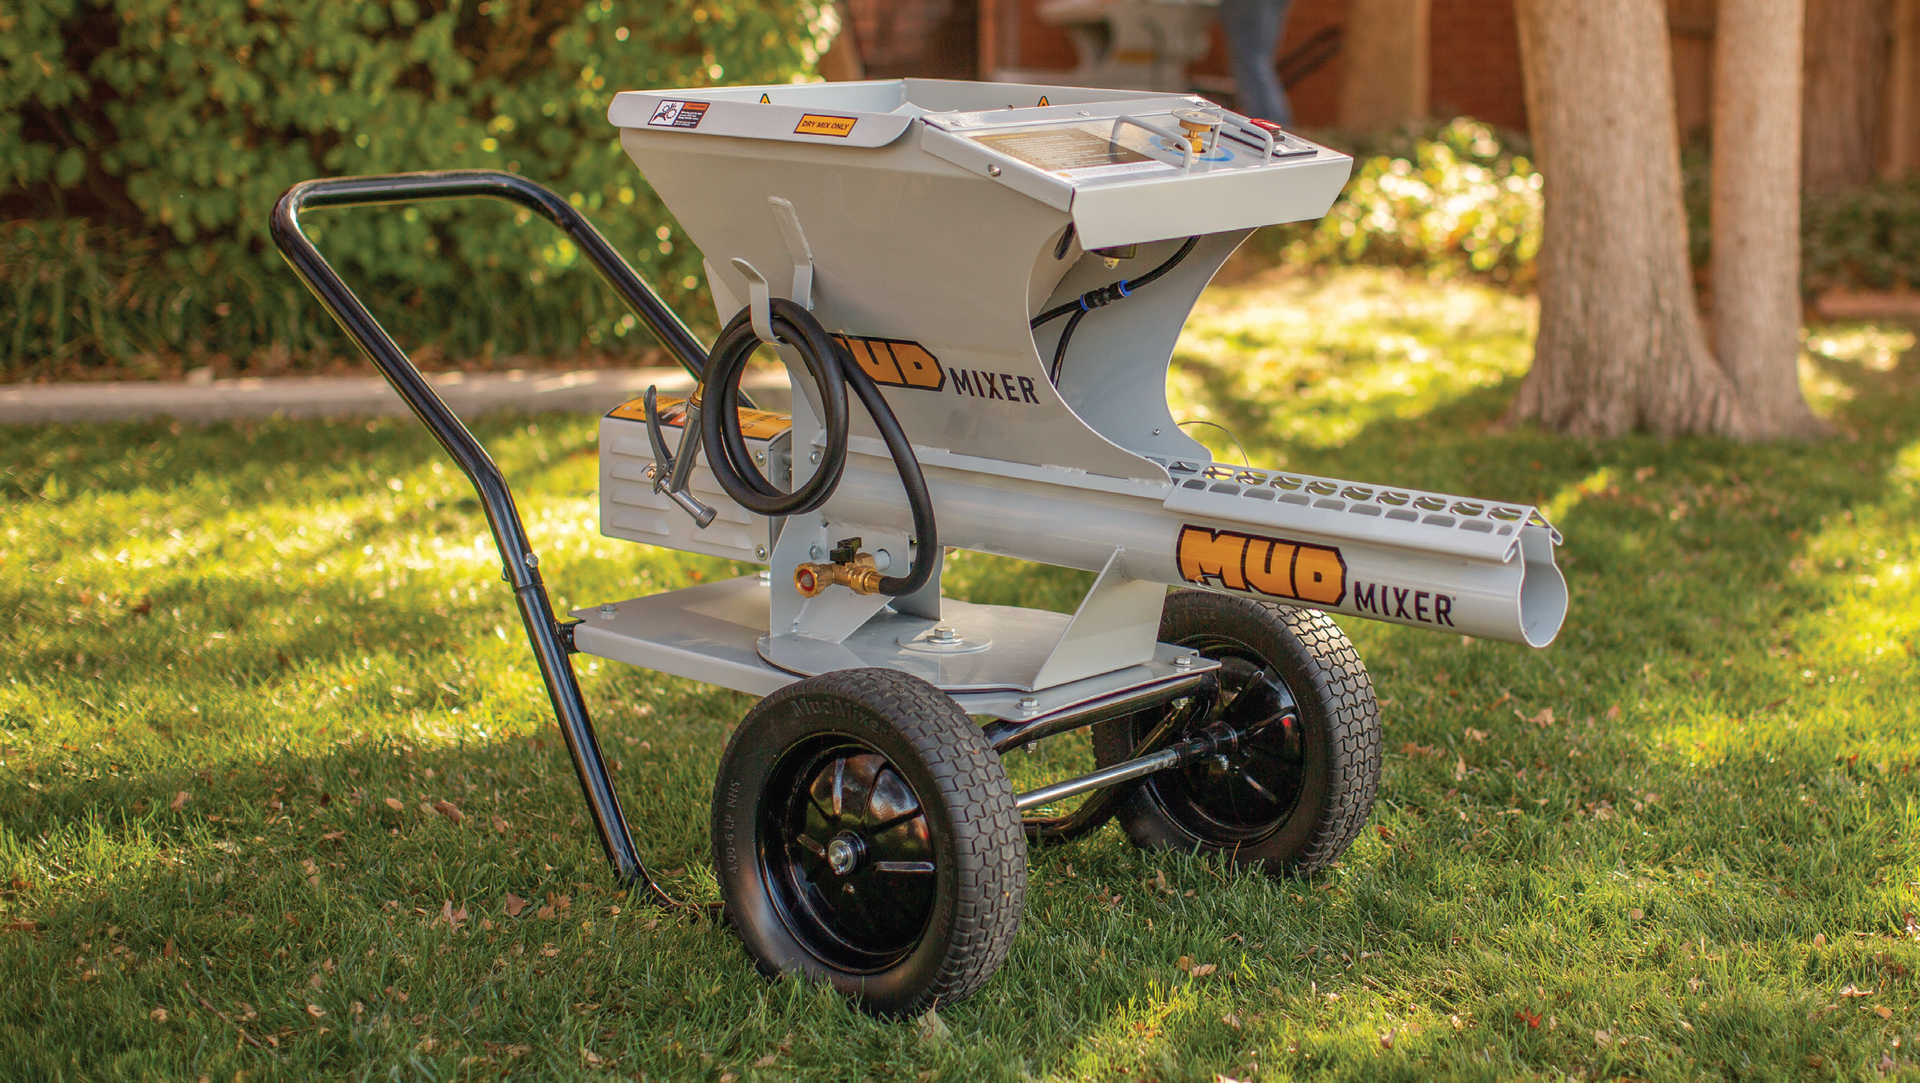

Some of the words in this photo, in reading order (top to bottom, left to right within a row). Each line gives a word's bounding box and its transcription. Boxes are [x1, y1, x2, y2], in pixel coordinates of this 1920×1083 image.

[802, 120, 817, 128] DRY
[816, 121, 831, 129] MIX
[831, 122, 849, 131] ONLY
[829, 333, 947, 392] UD
[1176, 524, 1348, 607] MUD
[726, 780, 741, 808] NHS
